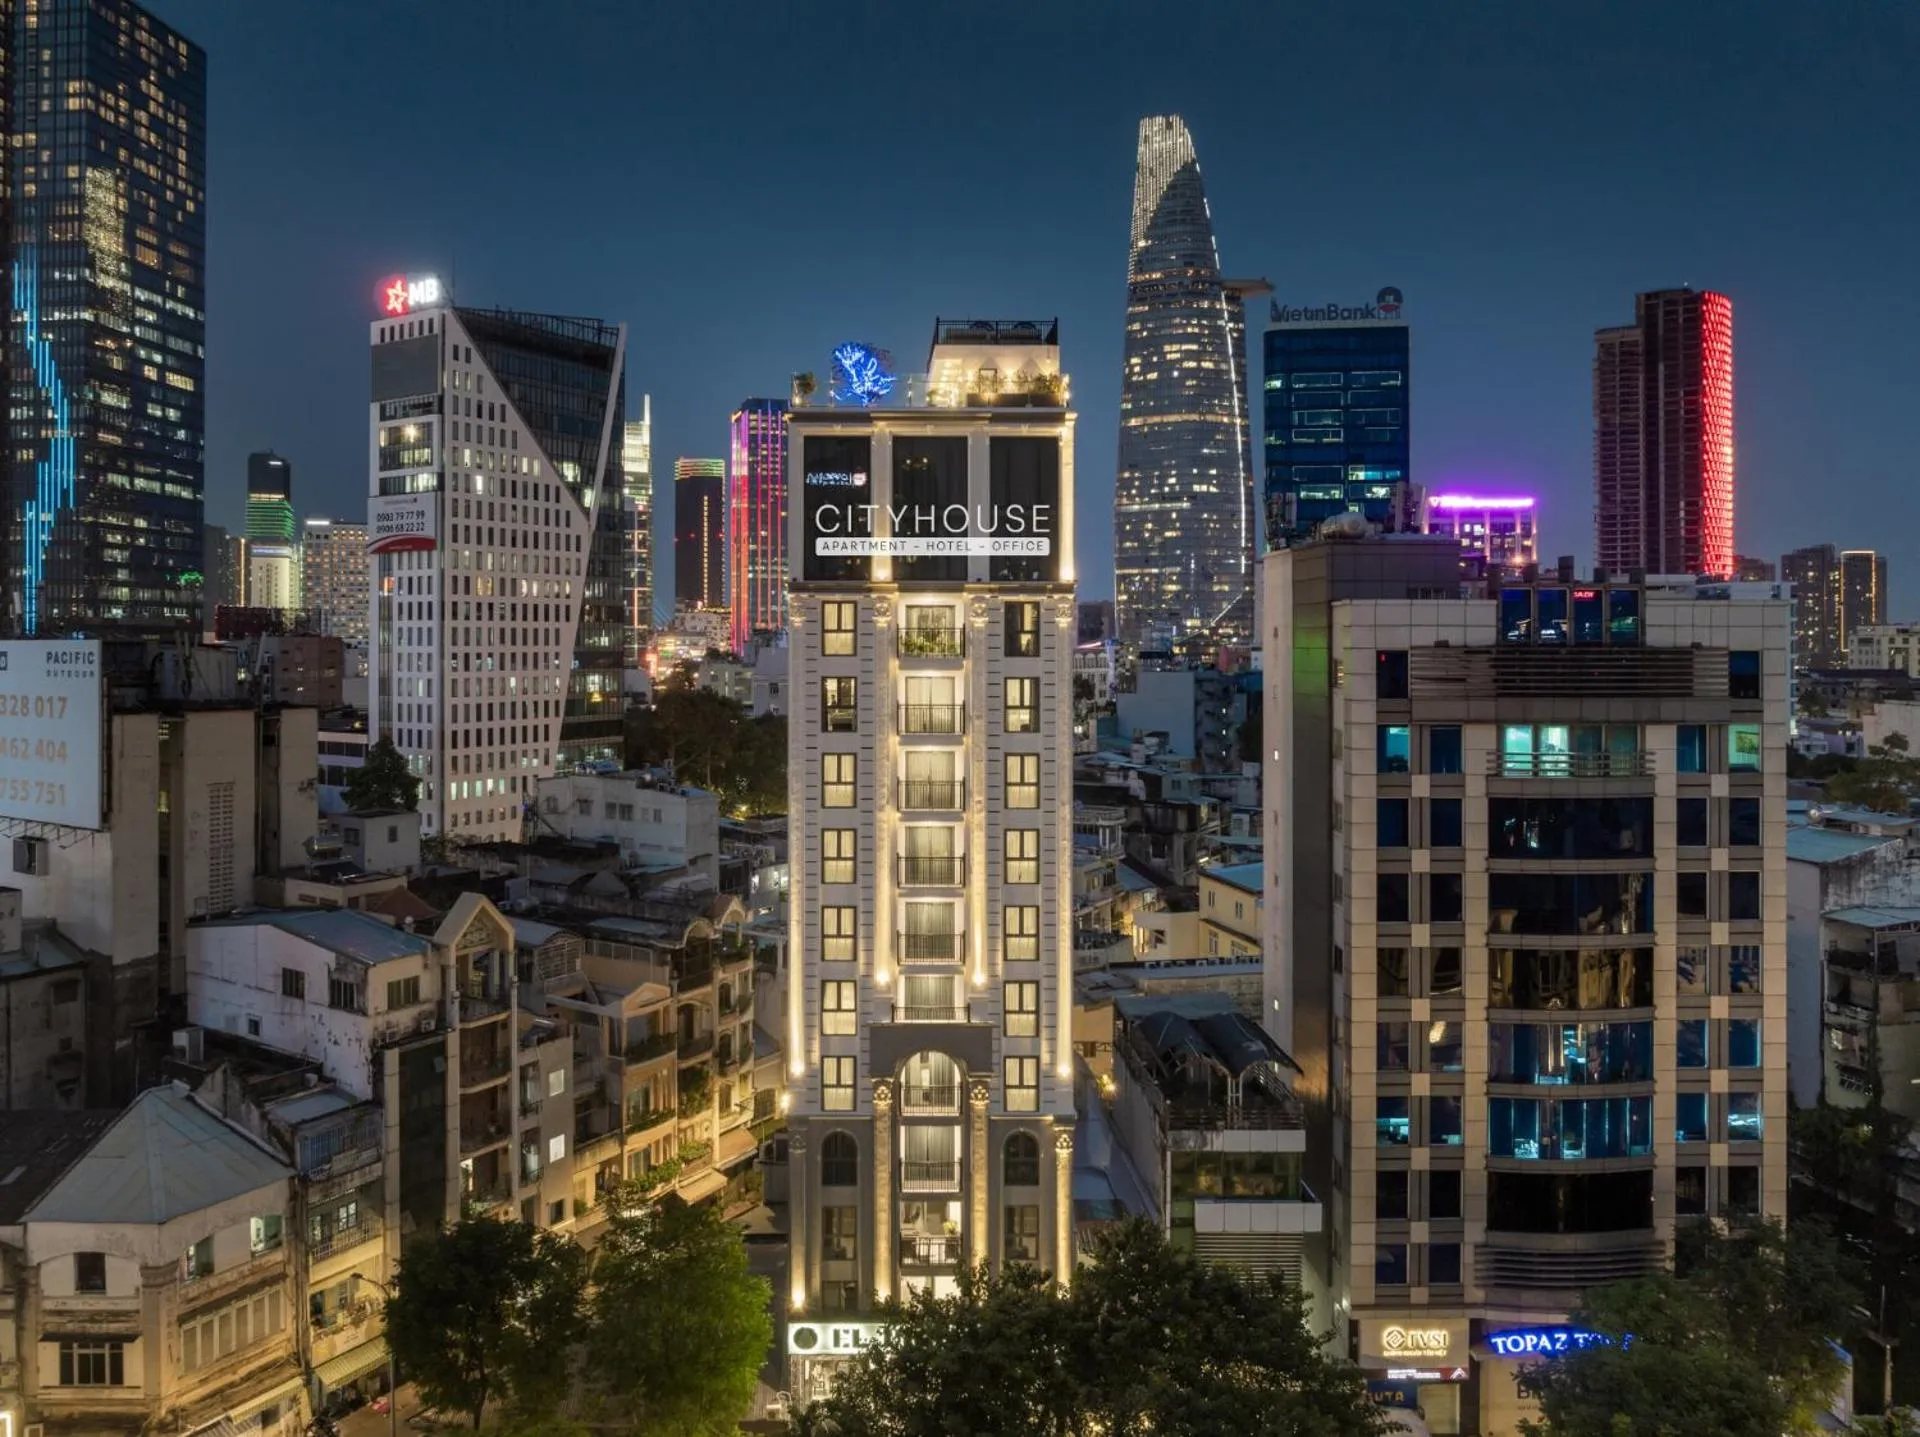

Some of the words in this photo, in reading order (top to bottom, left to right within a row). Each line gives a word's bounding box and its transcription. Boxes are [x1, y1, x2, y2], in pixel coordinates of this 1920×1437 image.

[408, 280, 438, 305] MB
[46, 651, 96, 665] PACIFIC
[35, 695, 68, 719] 017
[35, 738, 67, 764] 404
[35, 781, 66, 807] 751
[1491, 1333, 1568, 1354] TOPAZ
